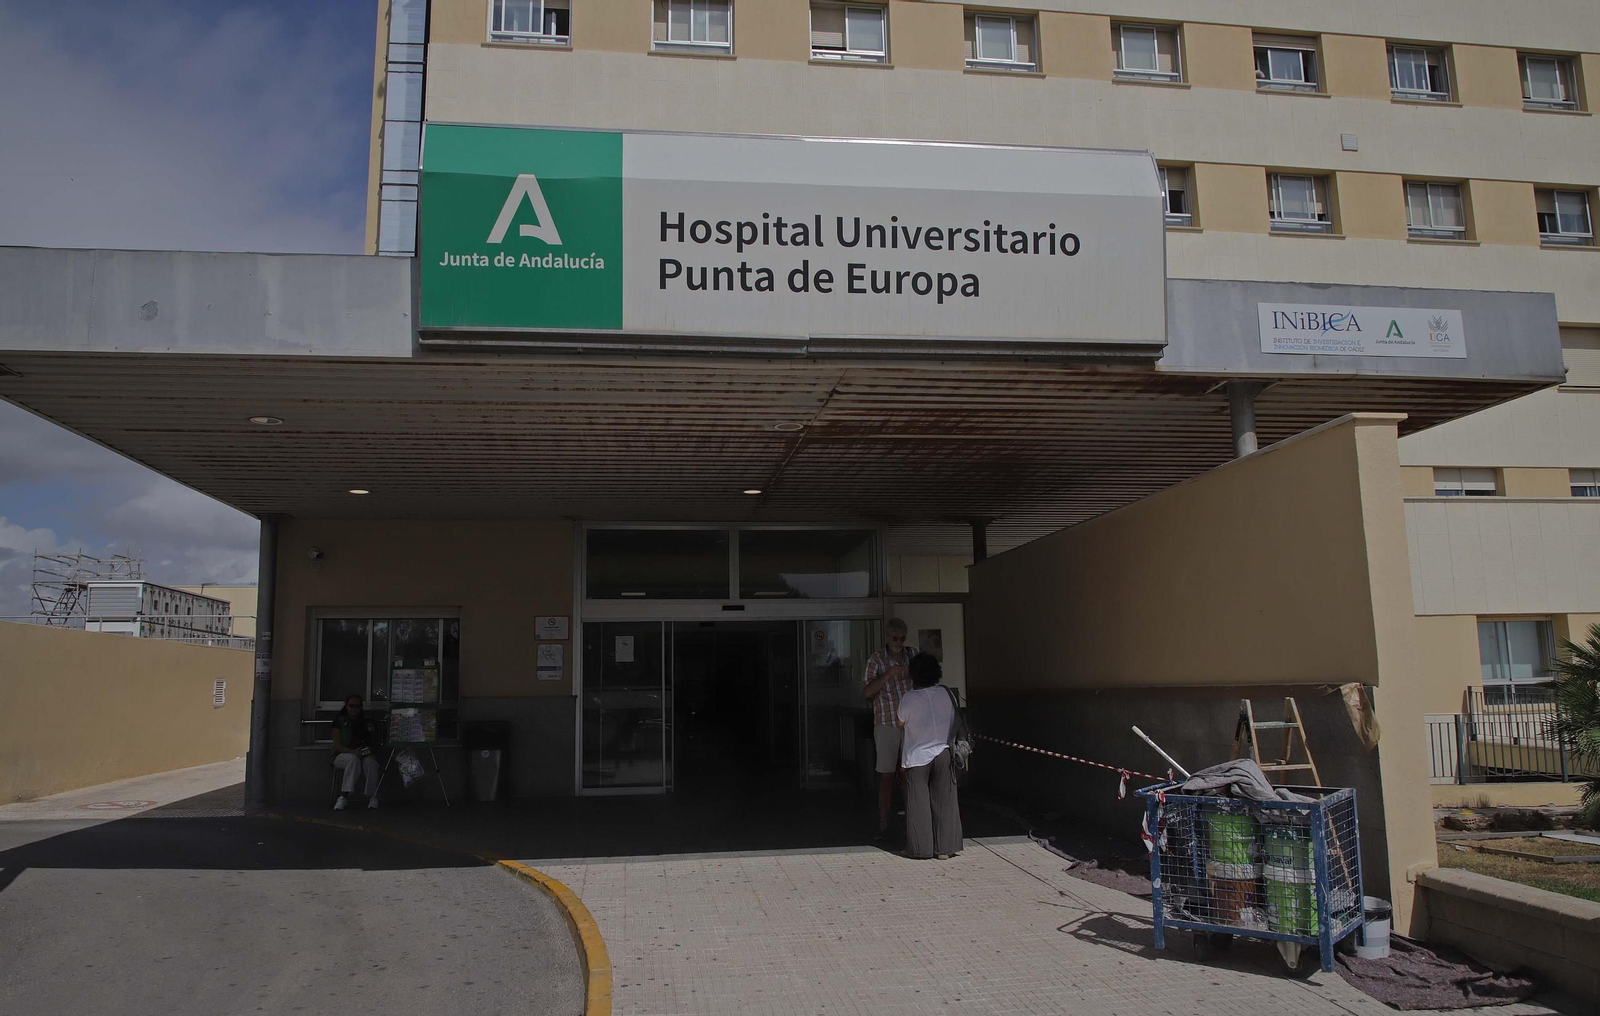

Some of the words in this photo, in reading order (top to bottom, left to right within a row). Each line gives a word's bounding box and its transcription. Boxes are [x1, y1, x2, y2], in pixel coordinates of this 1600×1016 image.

[660, 211, 824, 253] Hospital
[836, 215, 1080, 256] Universitario
[439, 252, 489, 267] Junta
[494, 252, 515, 267] de
[519, 252, 605, 269] Andalucía
[659, 258, 775, 292] Punta
[787, 259, 834, 294] de
[847, 262, 980, 304] Europa
[1271, 310, 1363, 332] INiBICA
[1430, 332, 1451, 342] UCA
